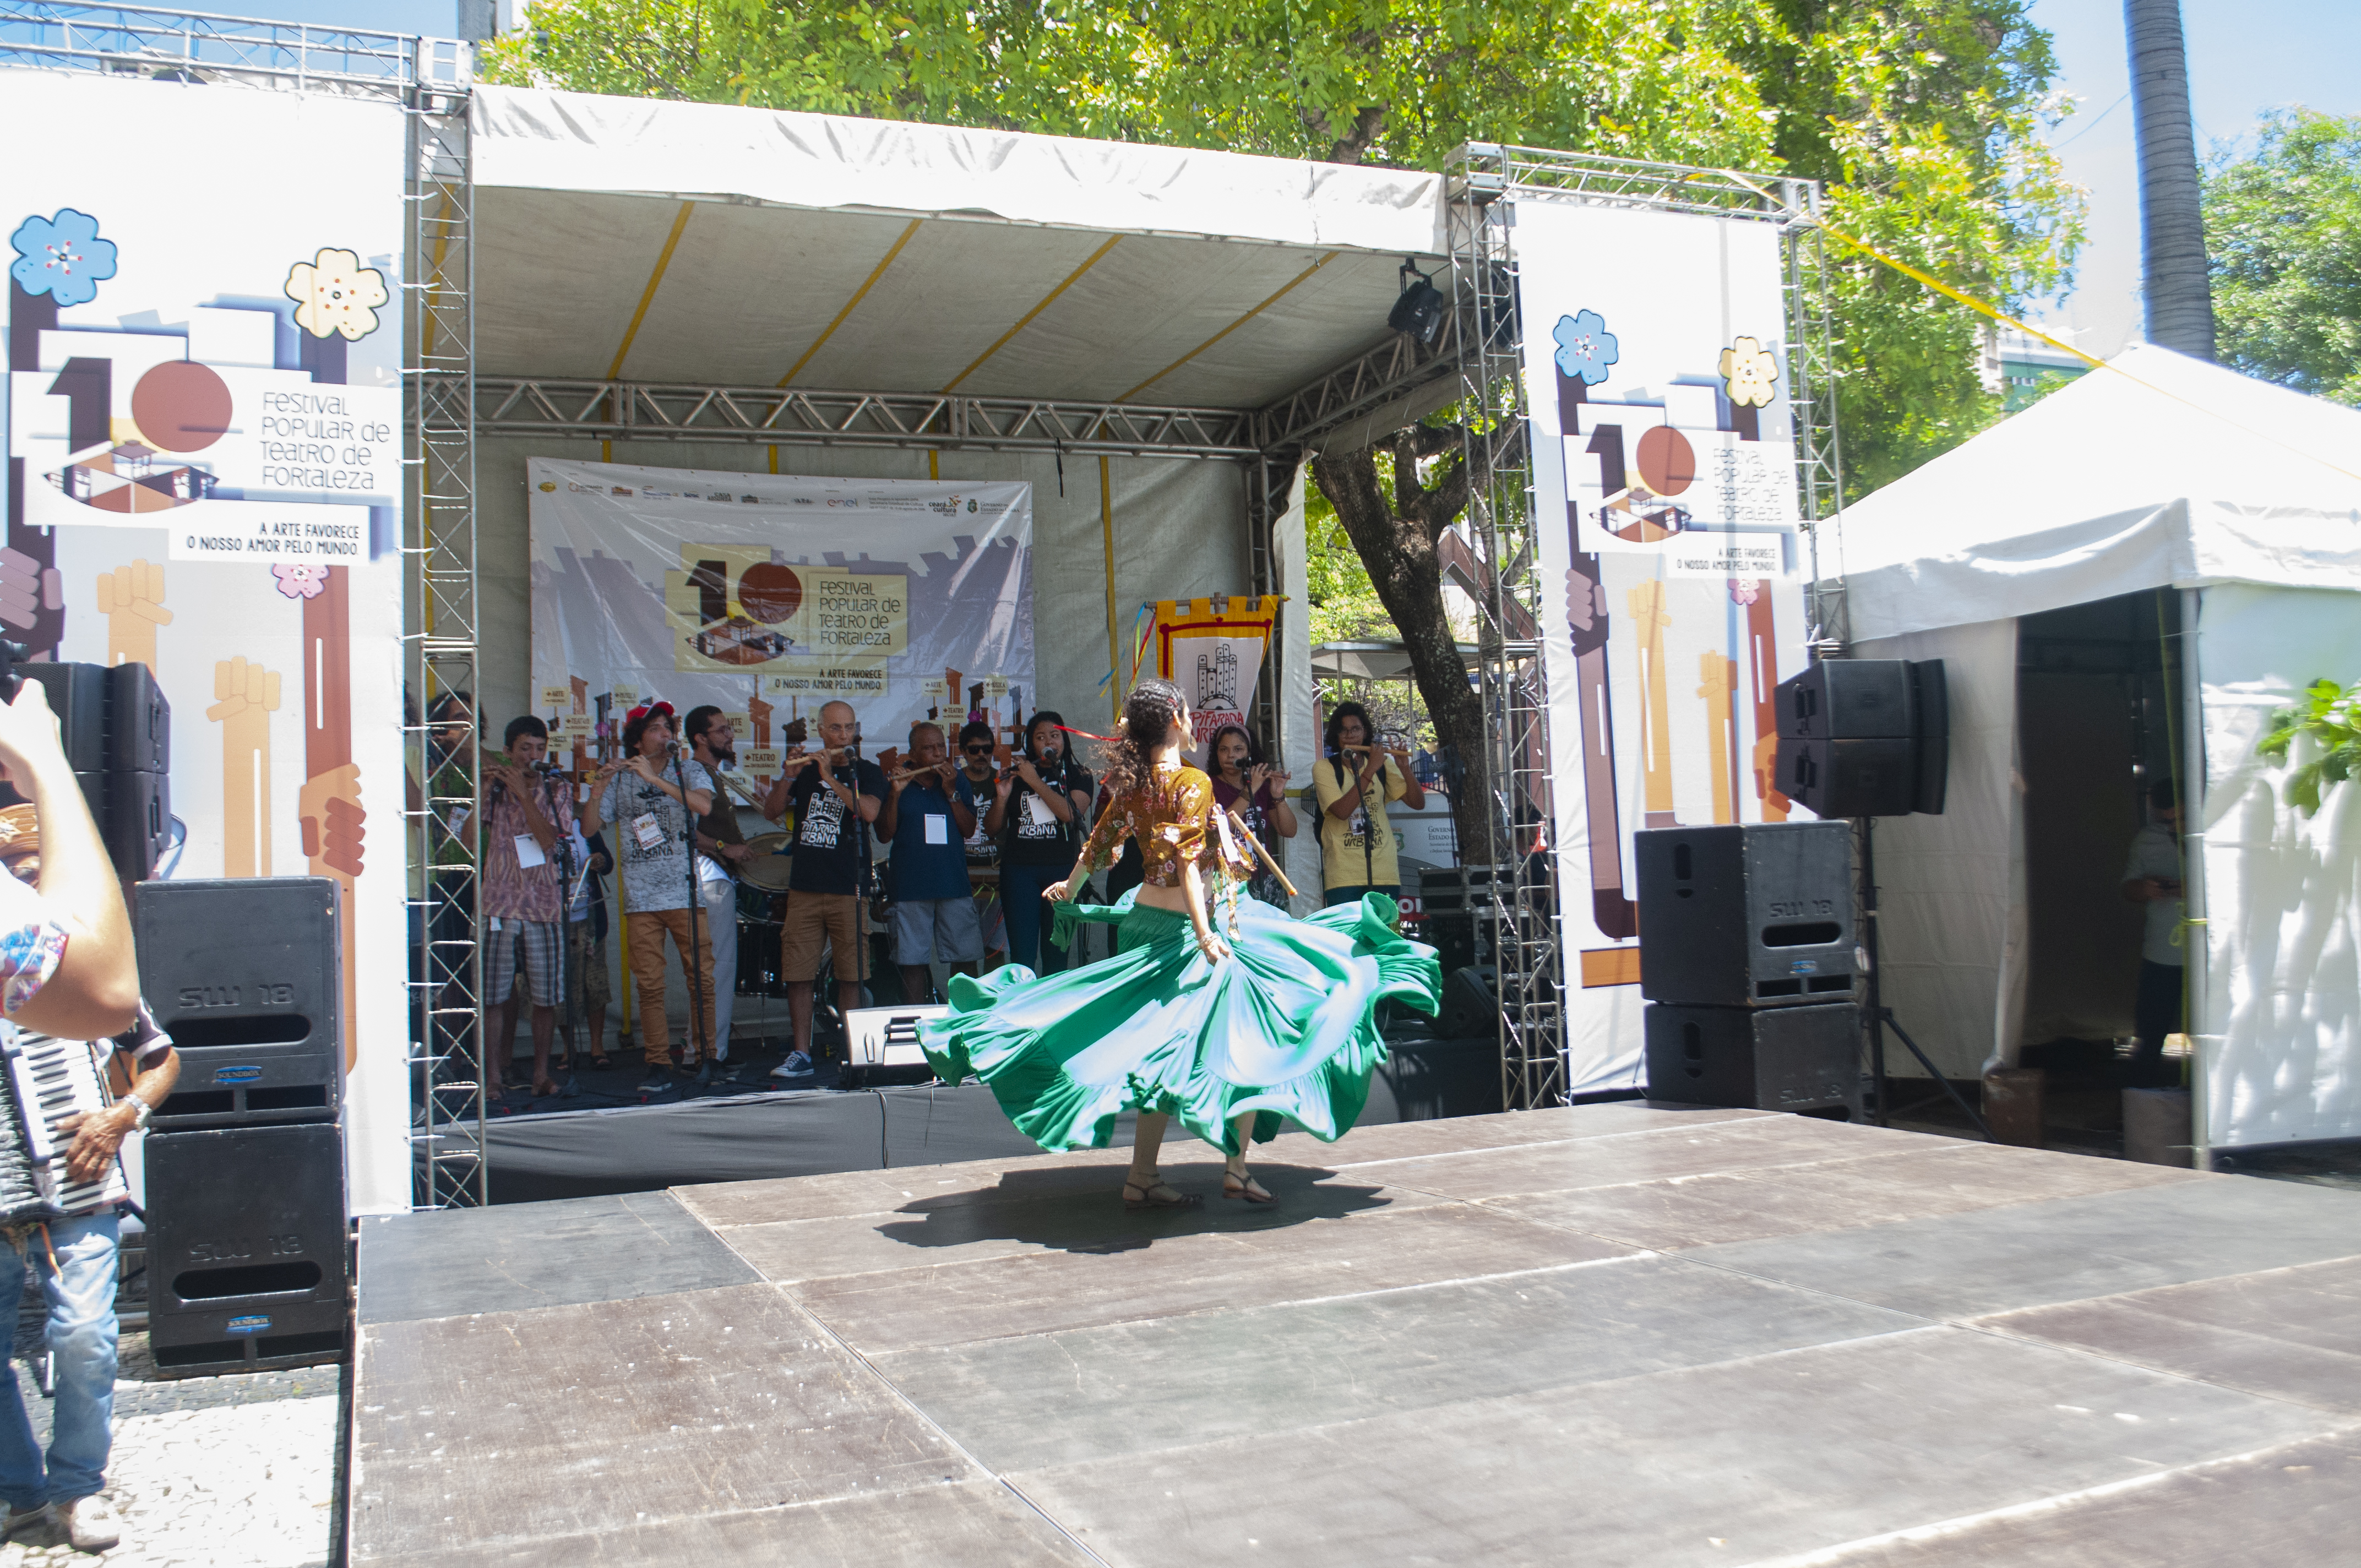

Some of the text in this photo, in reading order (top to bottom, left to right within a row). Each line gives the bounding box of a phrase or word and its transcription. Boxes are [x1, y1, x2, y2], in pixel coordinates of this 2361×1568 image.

[361, 421, 390, 444] de
[342, 444, 372, 466] de
[827, 498, 858, 507] enel
[259, 522, 360, 540] A ARTE FAVORECE
[187, 535, 195, 549] O
[199, 536, 242, 551] NOSSO
[247, 538, 281, 553] AMOR
[285, 540, 313, 554] PELO
[1718, 548, 1776, 559] A ARTE FAVORECE
[1677, 558, 1682, 569] O
[1684, 559, 1709, 570] NOSSO
[1712, 560, 1731, 571] AMOR
[1733, 560, 1749, 571] PELO
[882, 597, 901, 613] de
[870, 614, 889, 629] de
[819, 669, 882, 679] A ARTE FAVORECE
[775, 679, 780, 688] O
[783, 679, 809, 689] NOSSO
[812, 679, 833, 689] AMOR
[835, 680, 852, 690] PELO
[1019, 825, 1057, 836] URBANA
